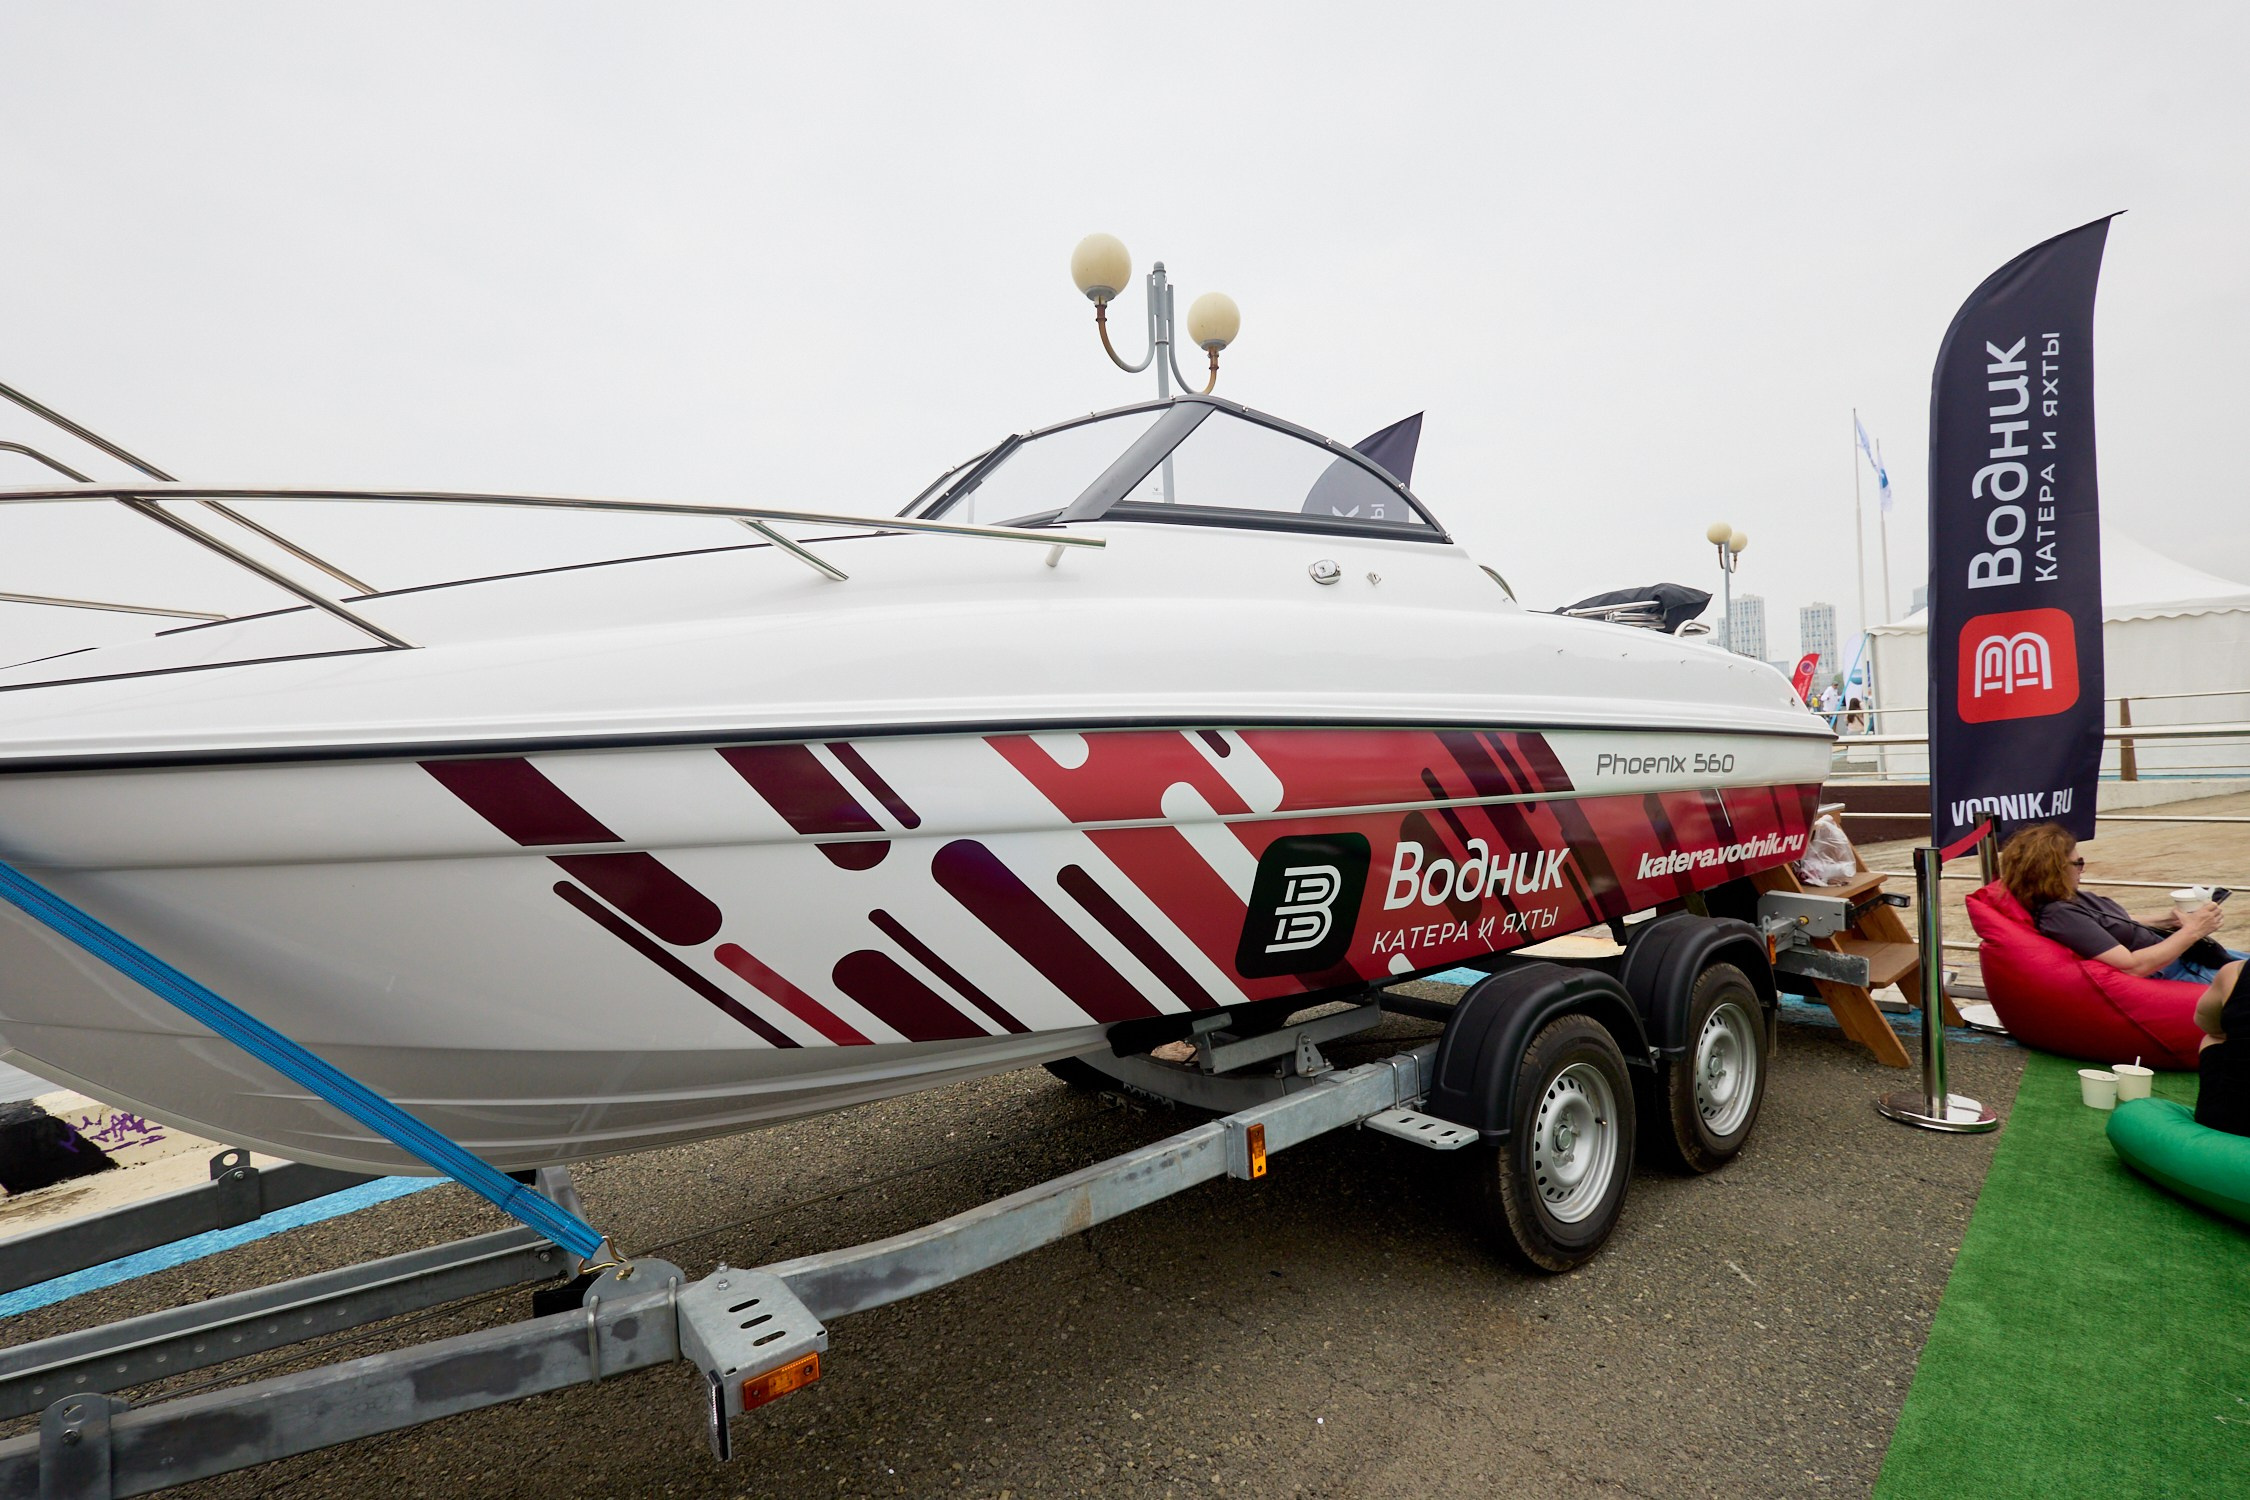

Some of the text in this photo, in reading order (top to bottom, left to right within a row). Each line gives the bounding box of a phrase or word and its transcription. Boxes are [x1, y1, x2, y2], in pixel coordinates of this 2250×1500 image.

[1967, 335, 2030, 589] Водник
[2034, 332, 2060, 582] КАТЕРА И ЯХТЫ
[1596, 753, 1735, 776] Phoenix 560
[1951, 787, 2073, 827] VODNIK.RU
[1383, 838, 1570, 911] Водник
[1636, 832, 1805, 880] katera.vodnik.ru
[1371, 906, 1559, 954] КАТЕРА И ЯХТЫ
